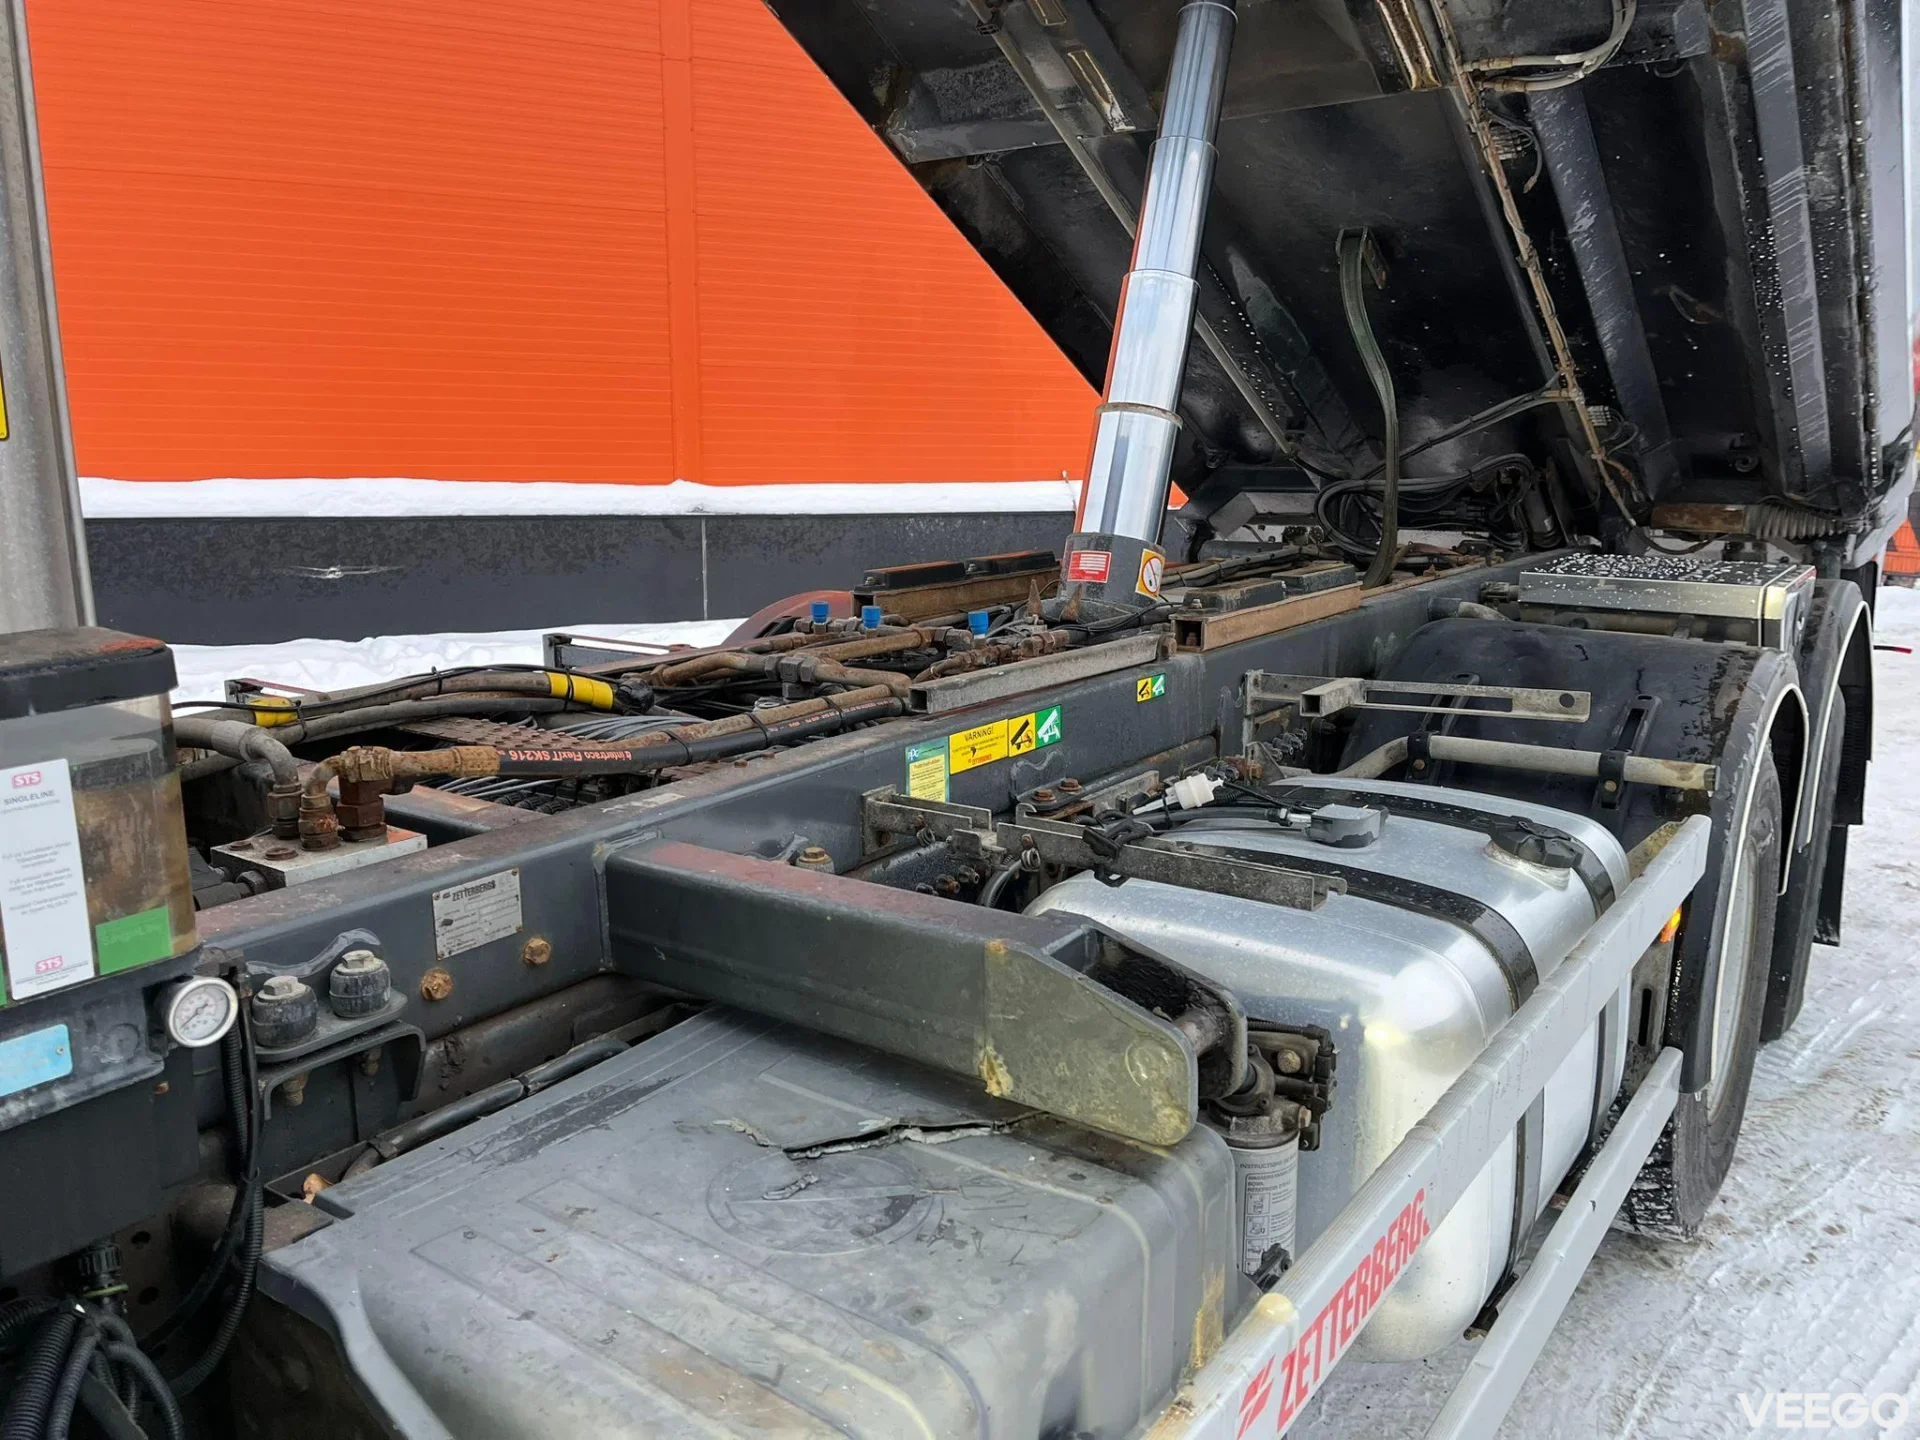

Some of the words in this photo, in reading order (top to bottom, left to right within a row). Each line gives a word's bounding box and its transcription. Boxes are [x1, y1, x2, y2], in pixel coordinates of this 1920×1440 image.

[964, 726, 994, 741] VARNING!
[509, 750, 551, 761] SK216
[552, 750, 583, 762] FlexIT
[14, 771, 41, 787] STS
[3, 789, 55, 805] SINGLELINE
[37, 957, 63, 973] STS
[1277, 1188, 1431, 1433] ZETTERBERG
